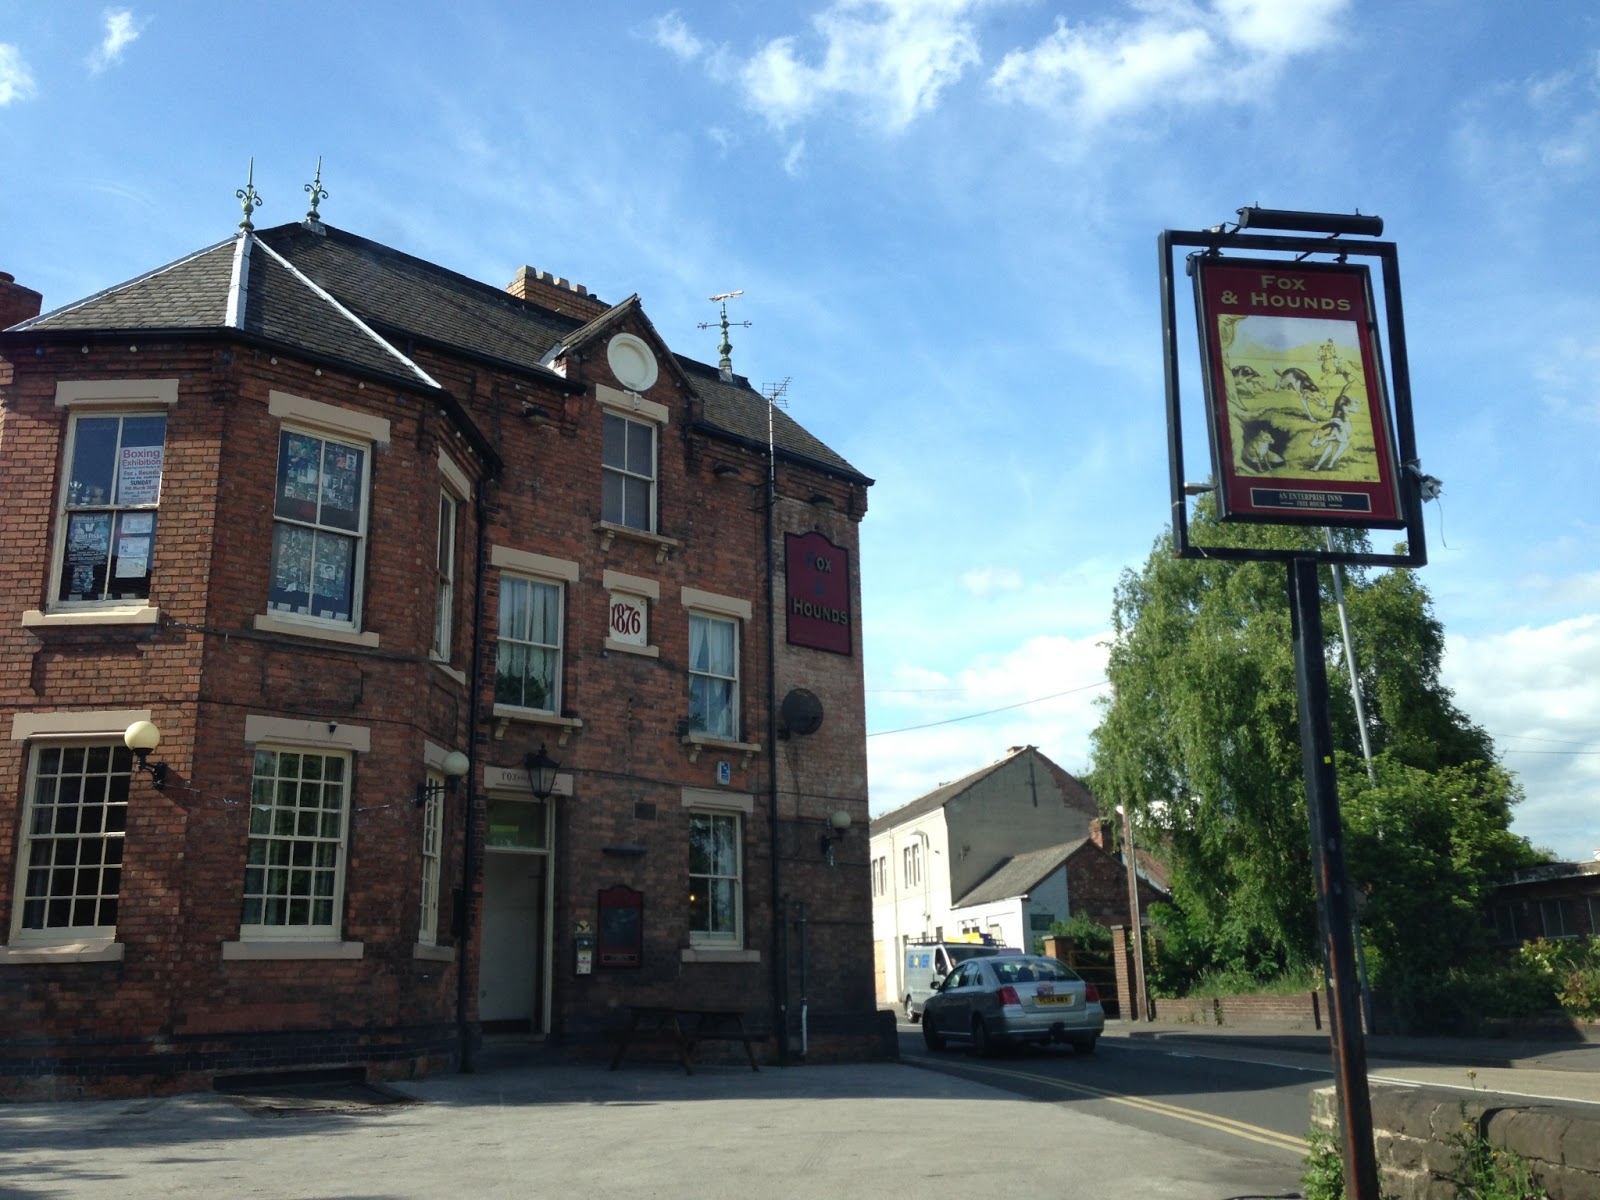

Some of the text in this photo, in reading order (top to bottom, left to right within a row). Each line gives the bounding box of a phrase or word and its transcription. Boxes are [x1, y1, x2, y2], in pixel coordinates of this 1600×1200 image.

[1261, 275, 1307, 291] FOX
[1221, 290, 1351, 311] & HOUNDS
[123, 449, 160, 459] Boxing
[1288, 493, 1326, 501] ENTERPRISE
[1327, 494, 1343, 502] INNS
[611, 603, 641, 635] 1876
[792, 597, 849, 625] HOUNDS
